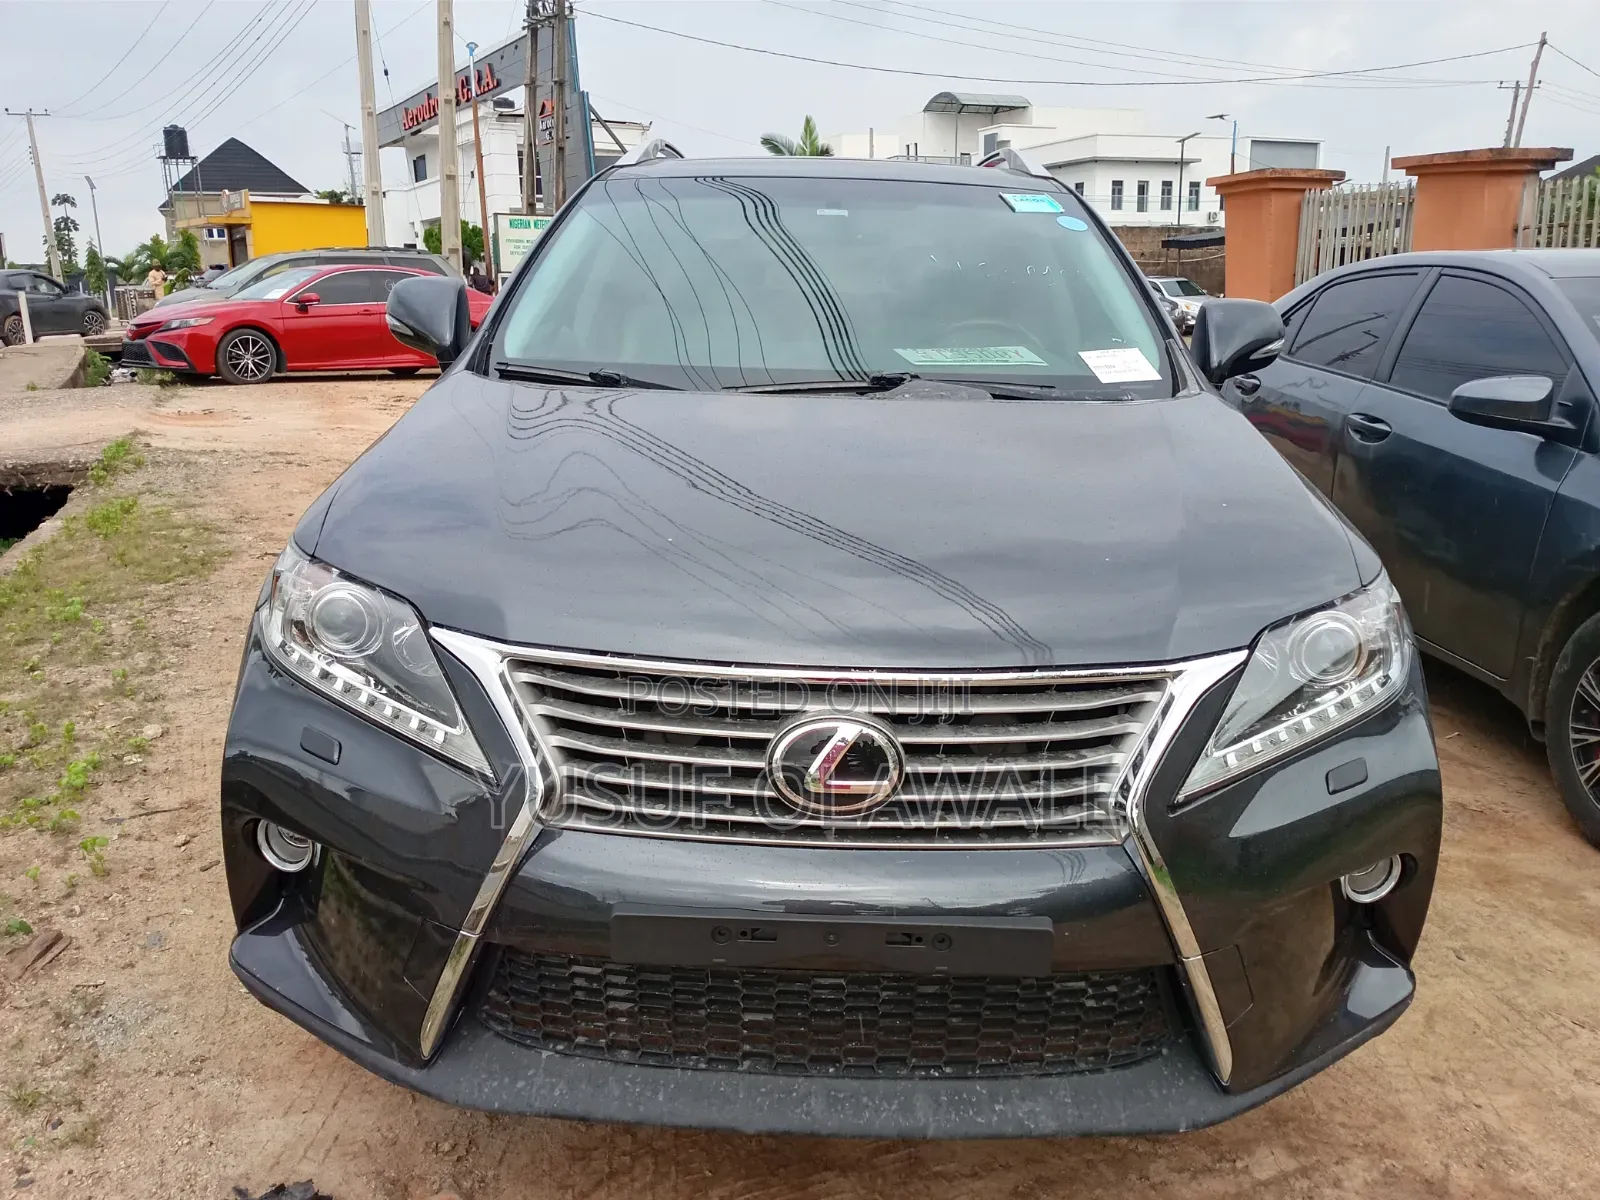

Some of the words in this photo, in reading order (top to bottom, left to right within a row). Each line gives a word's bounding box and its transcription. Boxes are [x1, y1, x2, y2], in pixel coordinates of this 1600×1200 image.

[402, 91, 440, 131] Aerodro
[509, 218, 531, 229] NIGERIAN
[534, 219, 550, 229] METEO
